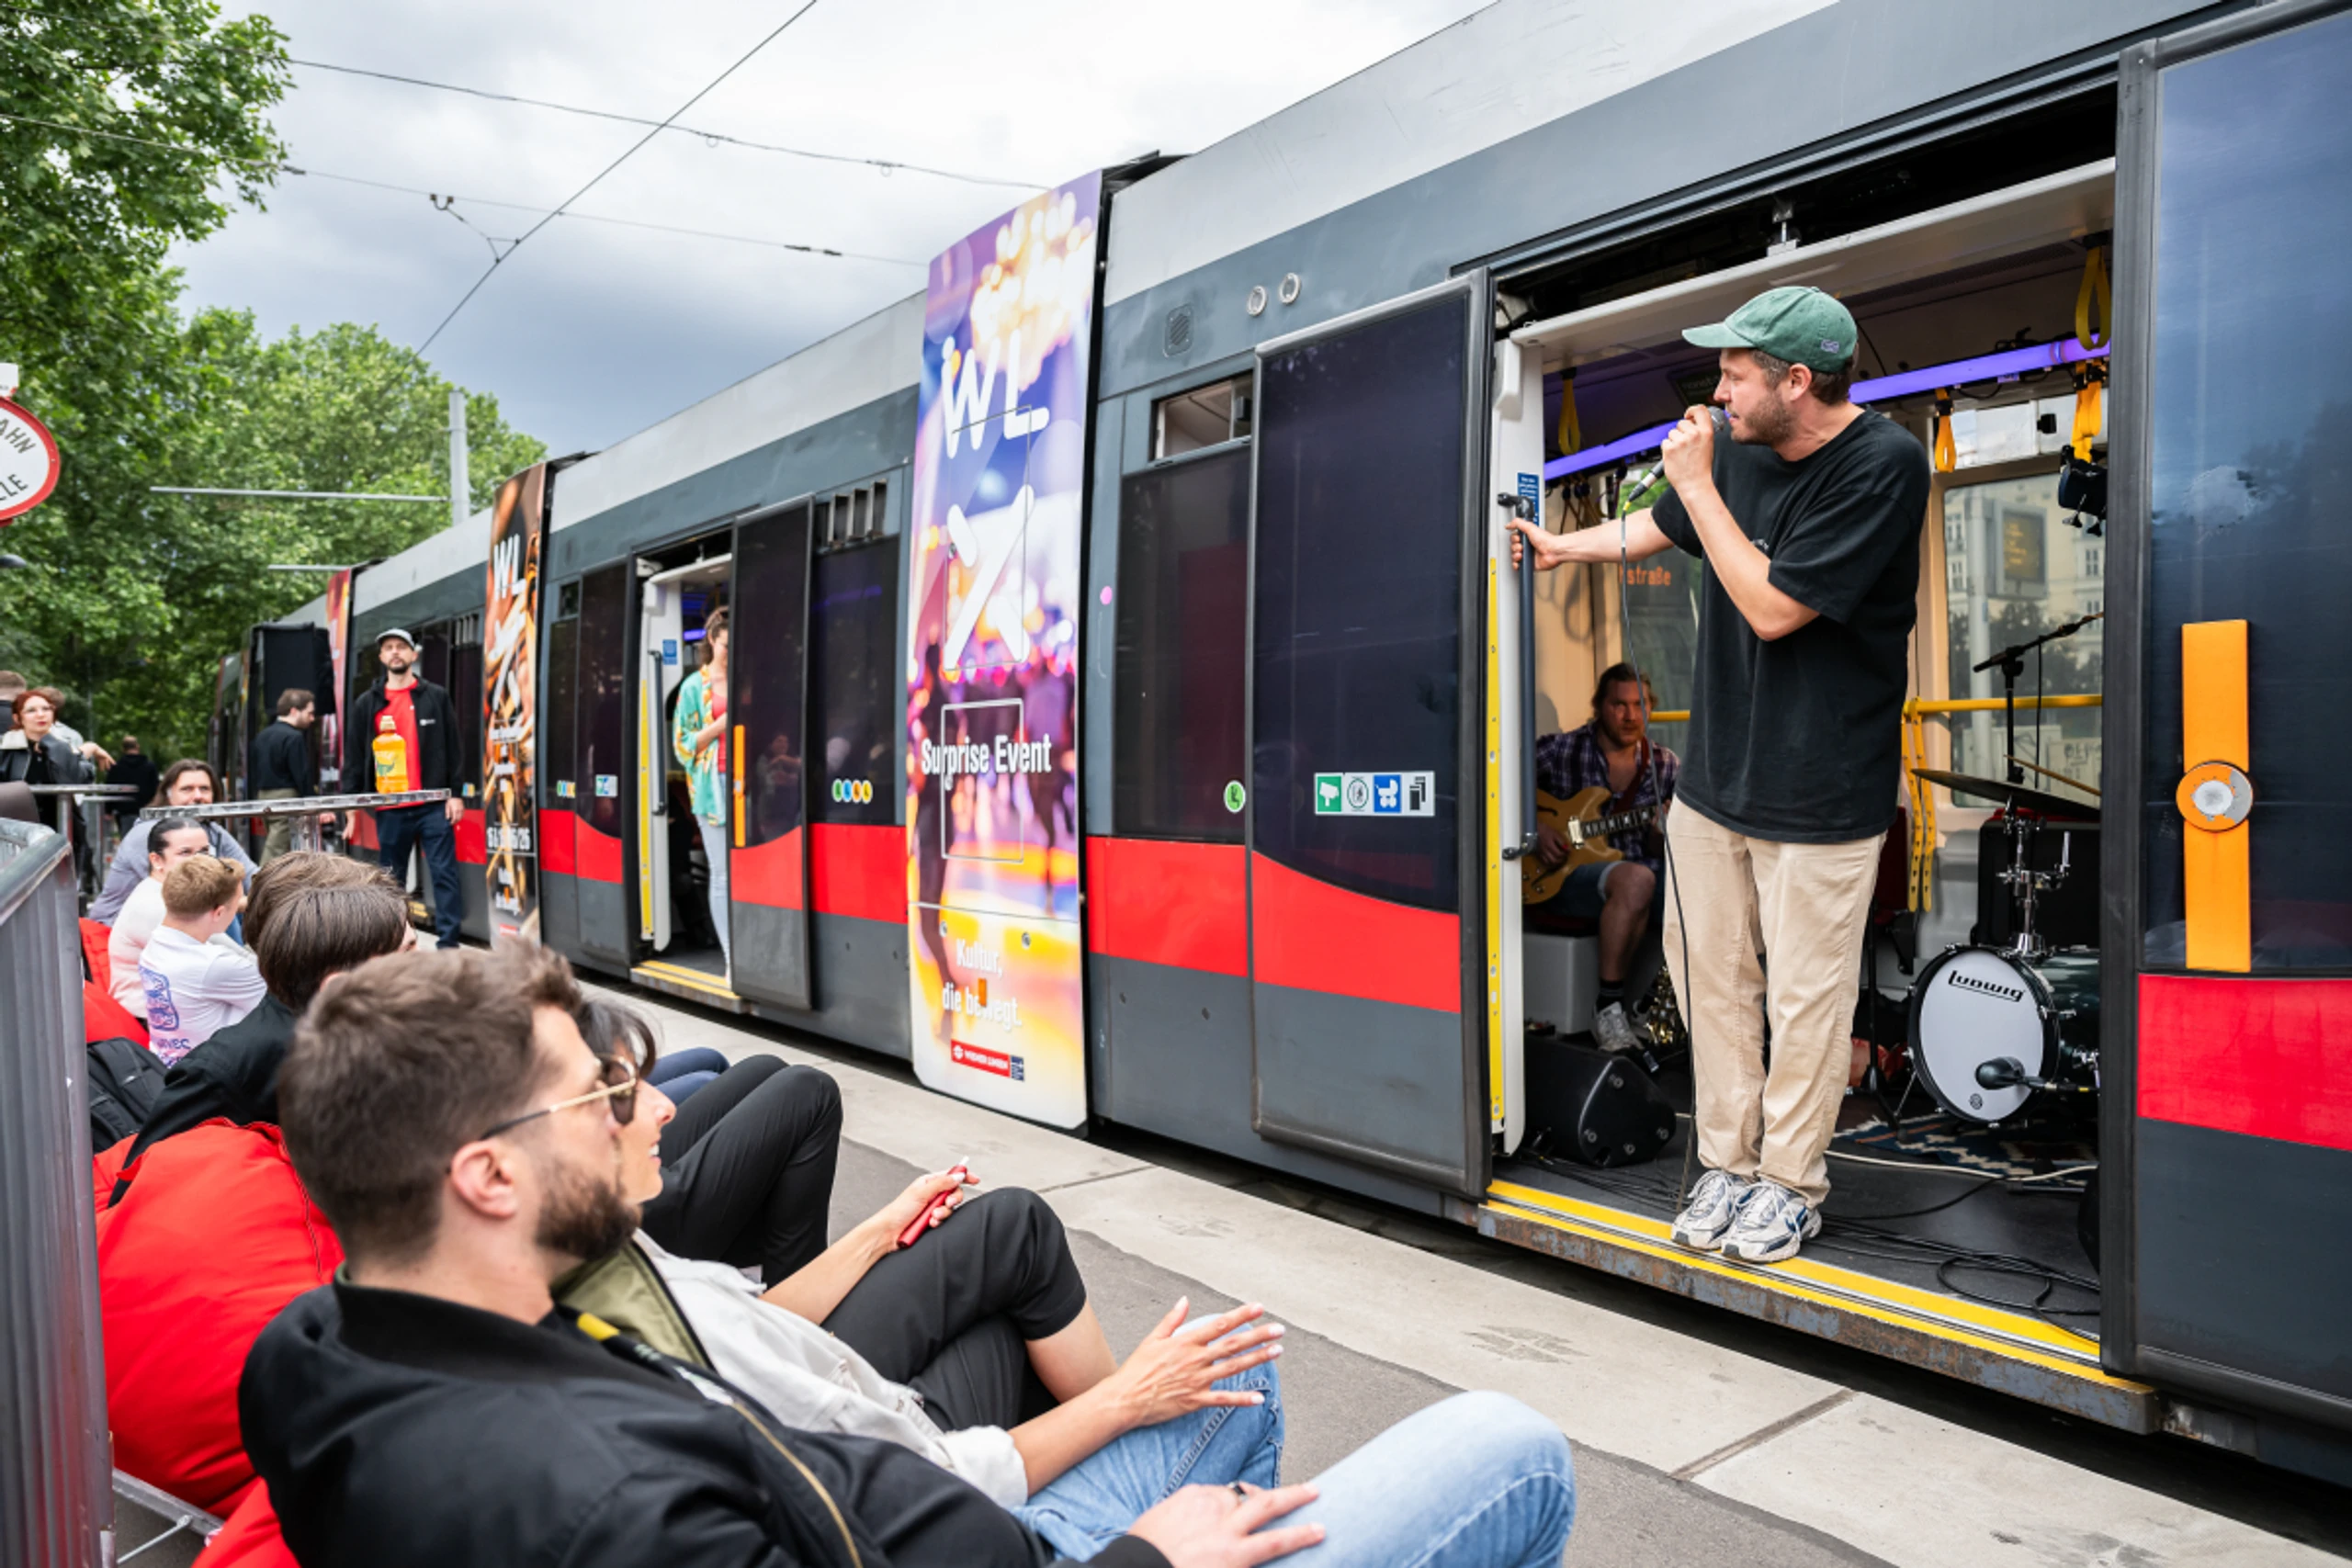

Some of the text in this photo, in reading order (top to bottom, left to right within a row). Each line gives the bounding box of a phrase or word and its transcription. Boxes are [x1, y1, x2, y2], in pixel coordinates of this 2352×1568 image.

[0, 473, 28, 501] LE
[921, 733, 1052, 777] Surprise Event
[956, 939, 1002, 977] Kultur,
[942, 981, 1022, 1032] die bewegt.
